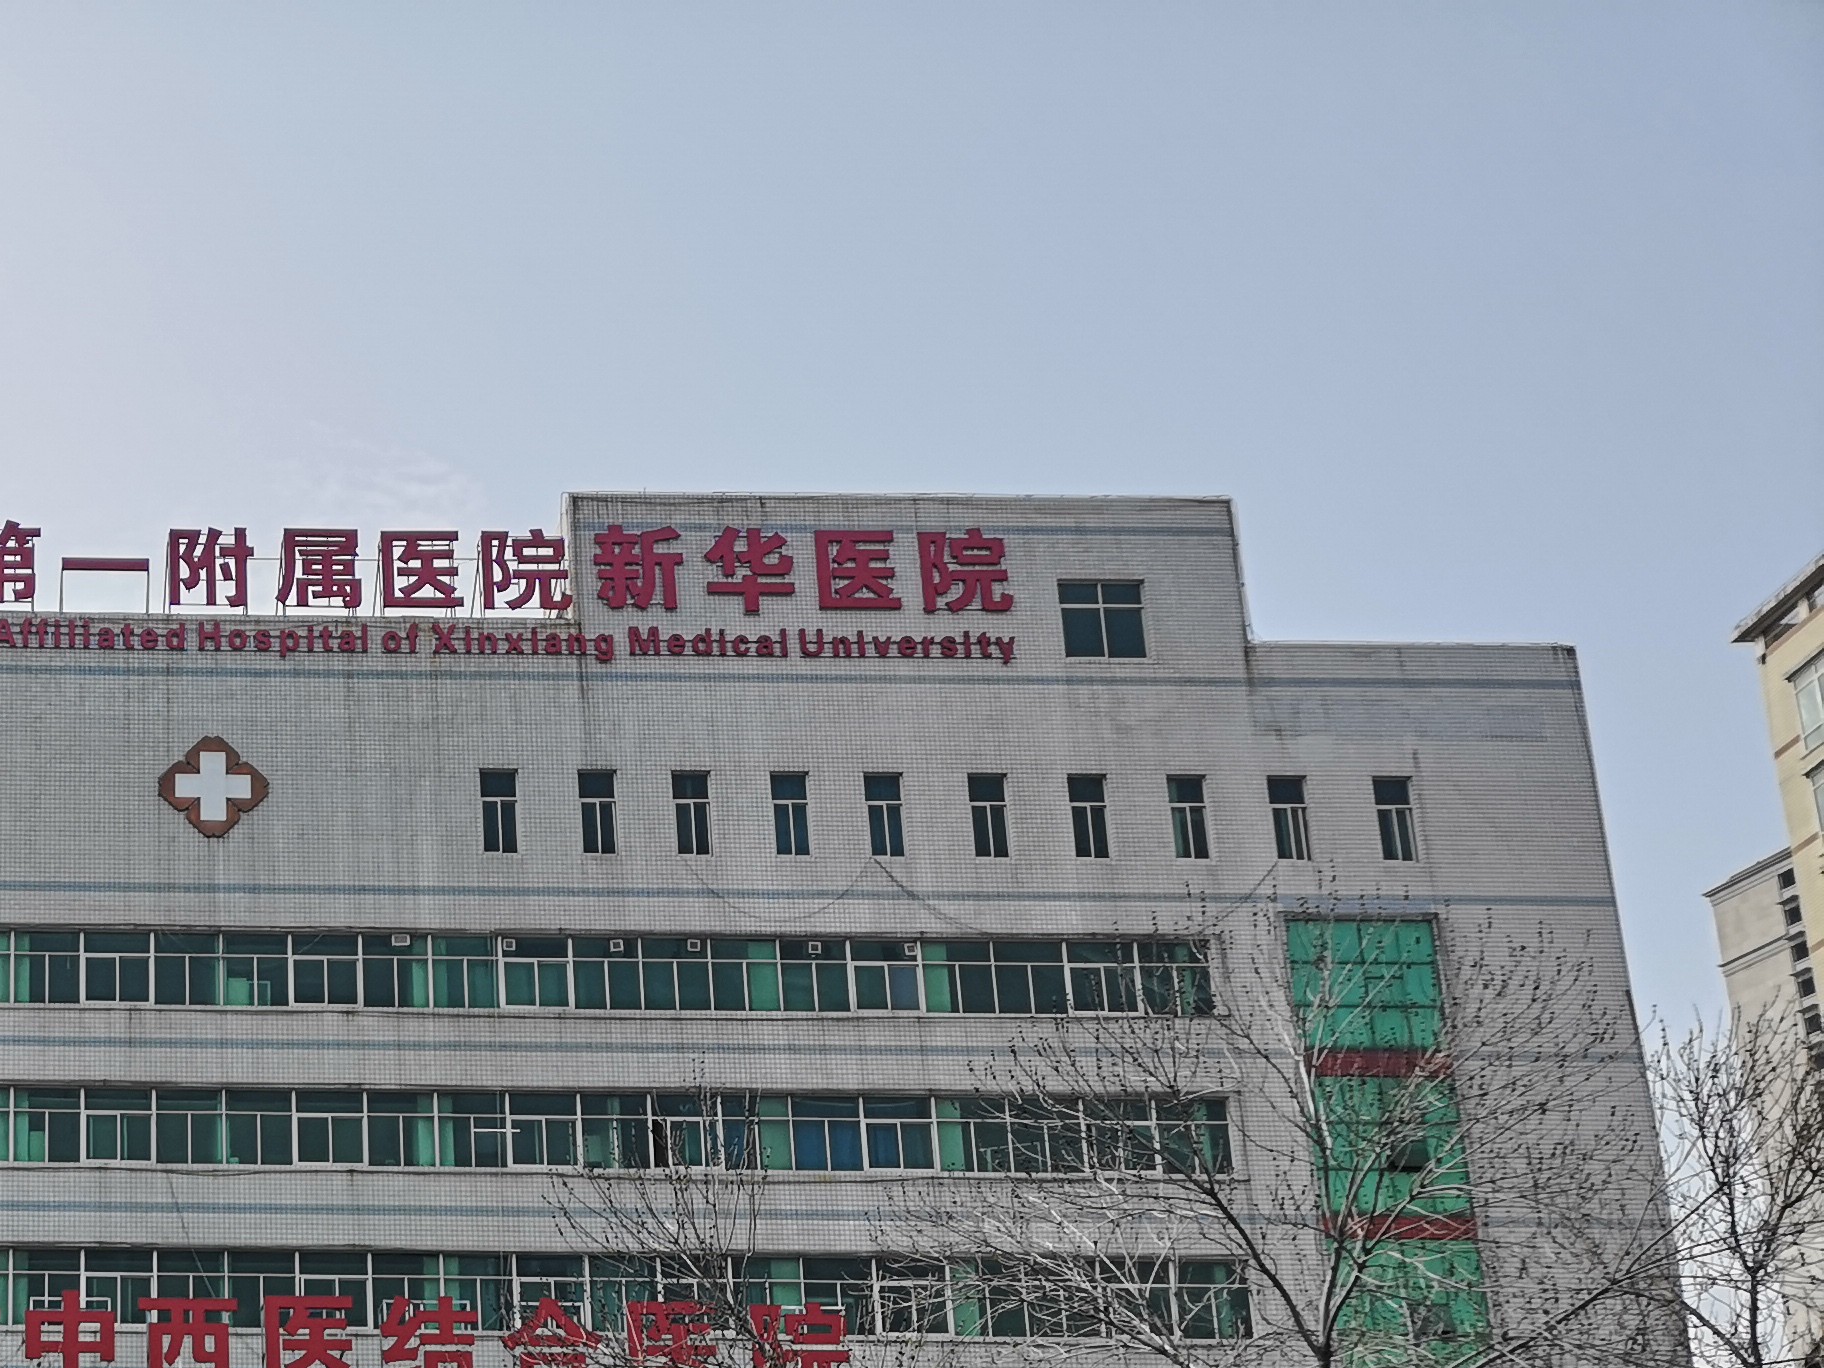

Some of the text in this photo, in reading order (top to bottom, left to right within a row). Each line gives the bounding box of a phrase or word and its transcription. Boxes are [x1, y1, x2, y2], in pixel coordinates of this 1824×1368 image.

[198, 620, 368, 657] Hospital
[382, 622, 420, 653] of
[433, 622, 615, 662] Xinxiang
[628, 625, 787, 657] Medical
[800, 627, 1017, 664] University
